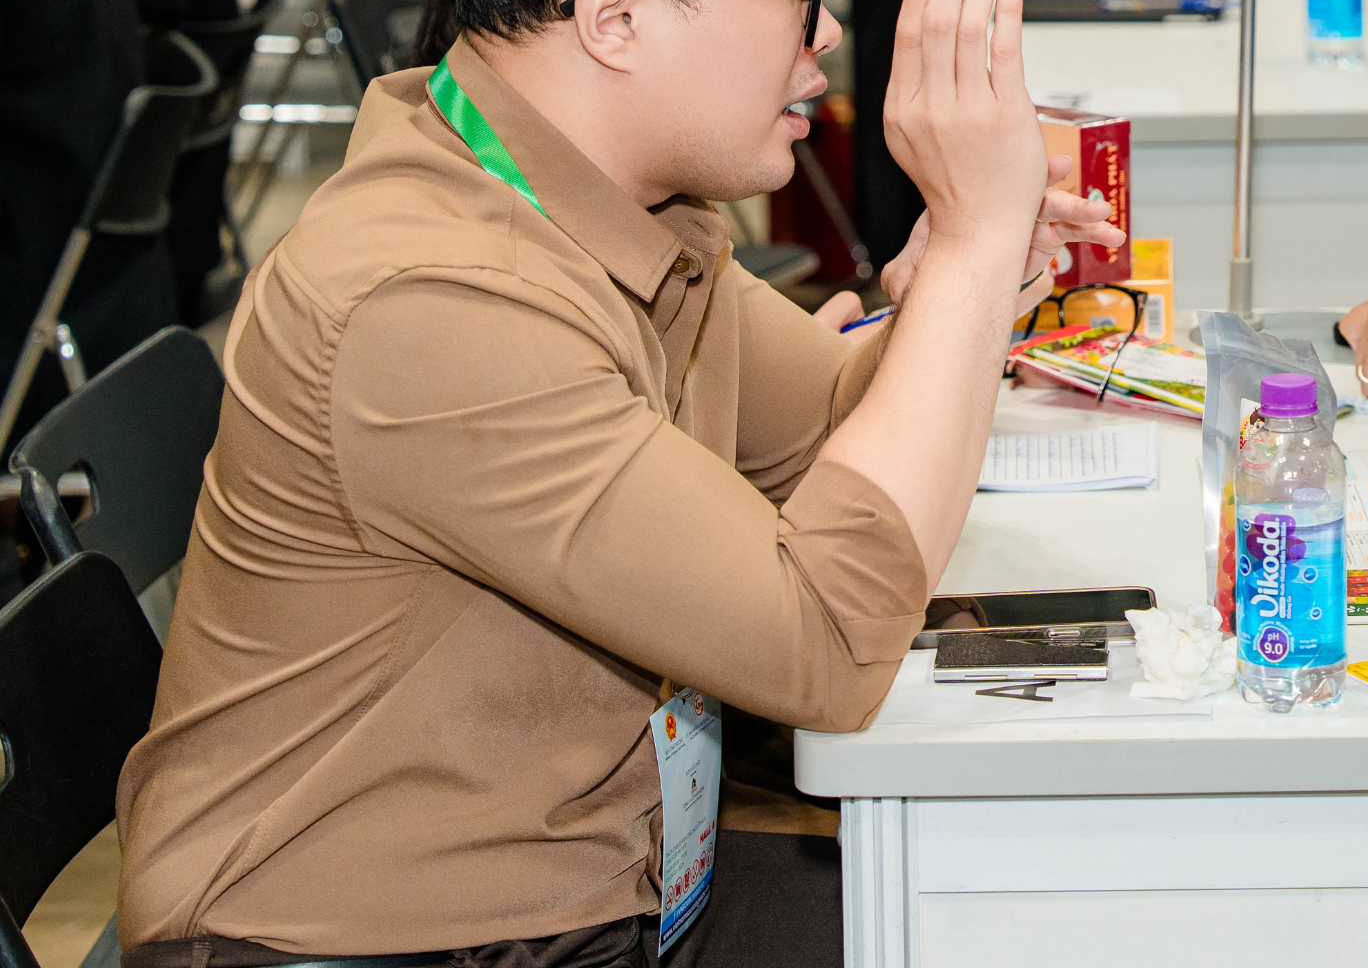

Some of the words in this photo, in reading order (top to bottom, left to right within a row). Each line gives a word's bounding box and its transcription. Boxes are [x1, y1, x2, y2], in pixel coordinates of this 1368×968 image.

[1250, 519, 1280, 618] Vikoda
[1267, 632, 1280, 641] pH
[1264, 642, 1283, 655] 9.0
[975, 680, 1057, 703] A
